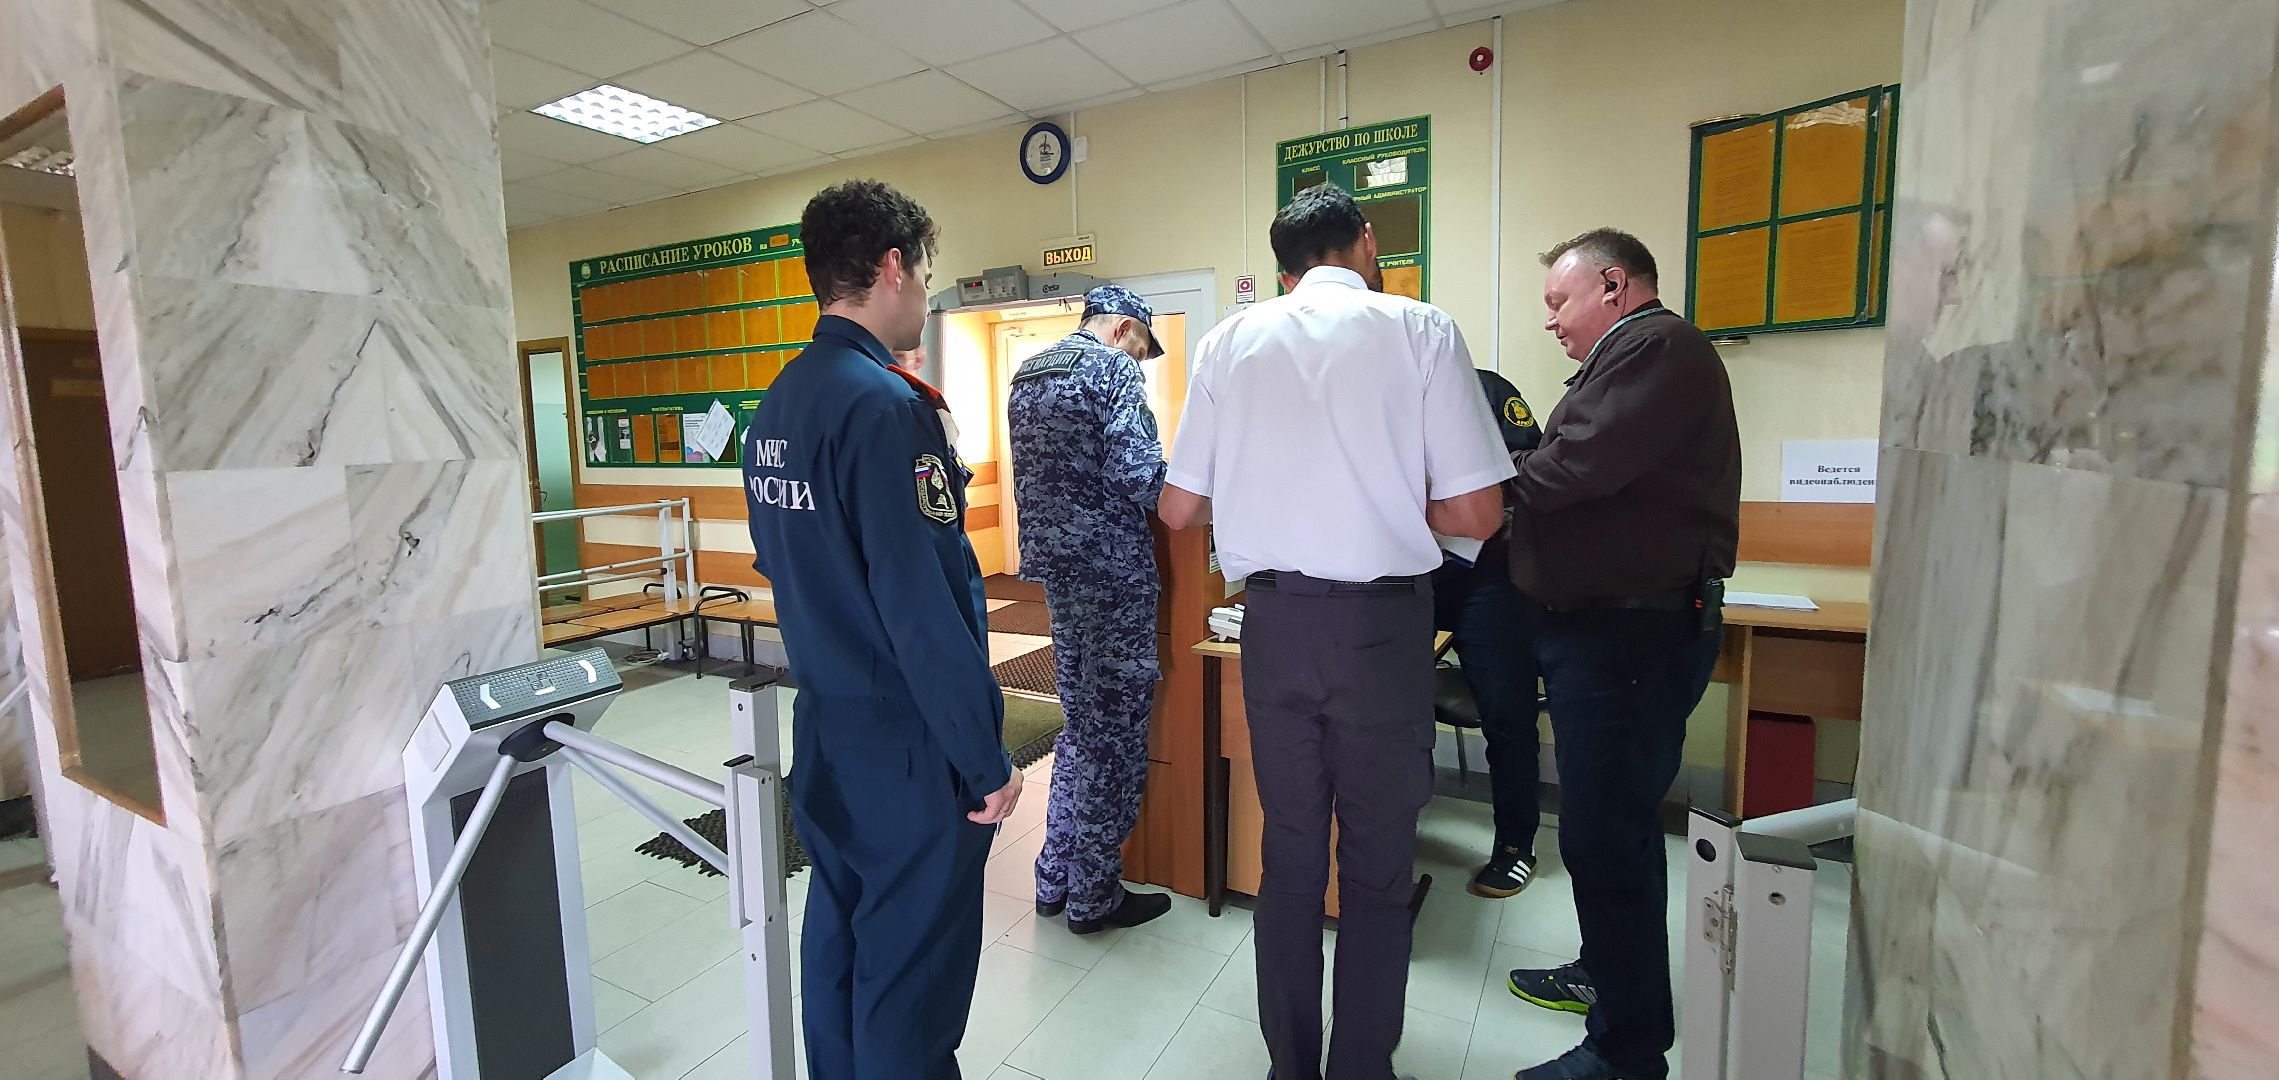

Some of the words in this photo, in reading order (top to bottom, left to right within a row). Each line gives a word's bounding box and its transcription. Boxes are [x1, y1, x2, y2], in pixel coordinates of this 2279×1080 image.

[1284, 135, 1350, 162] ДЕЖУРСТВО
[1354, 132, 1370, 147] ПО
[1374, 124, 1418, 143] ШКОЛЕ
[1342, 154, 1375, 165] КЛАССНЫЙ
[1377, 147, 1426, 159] РУКОВОДИТЕЛЬ
[1302, 165, 1320, 173] КЛАСС
[600, 247, 690, 275] РАСПИСАНИЕ
[693, 237, 753, 261] УРОКОВ
[1046, 247, 1091, 265] ВЫХОД
[755, 439, 788, 469] МЧС
[1817, 465, 1861, 473] Ведется
[1789, 477, 1875, 486] видеонаблюден
